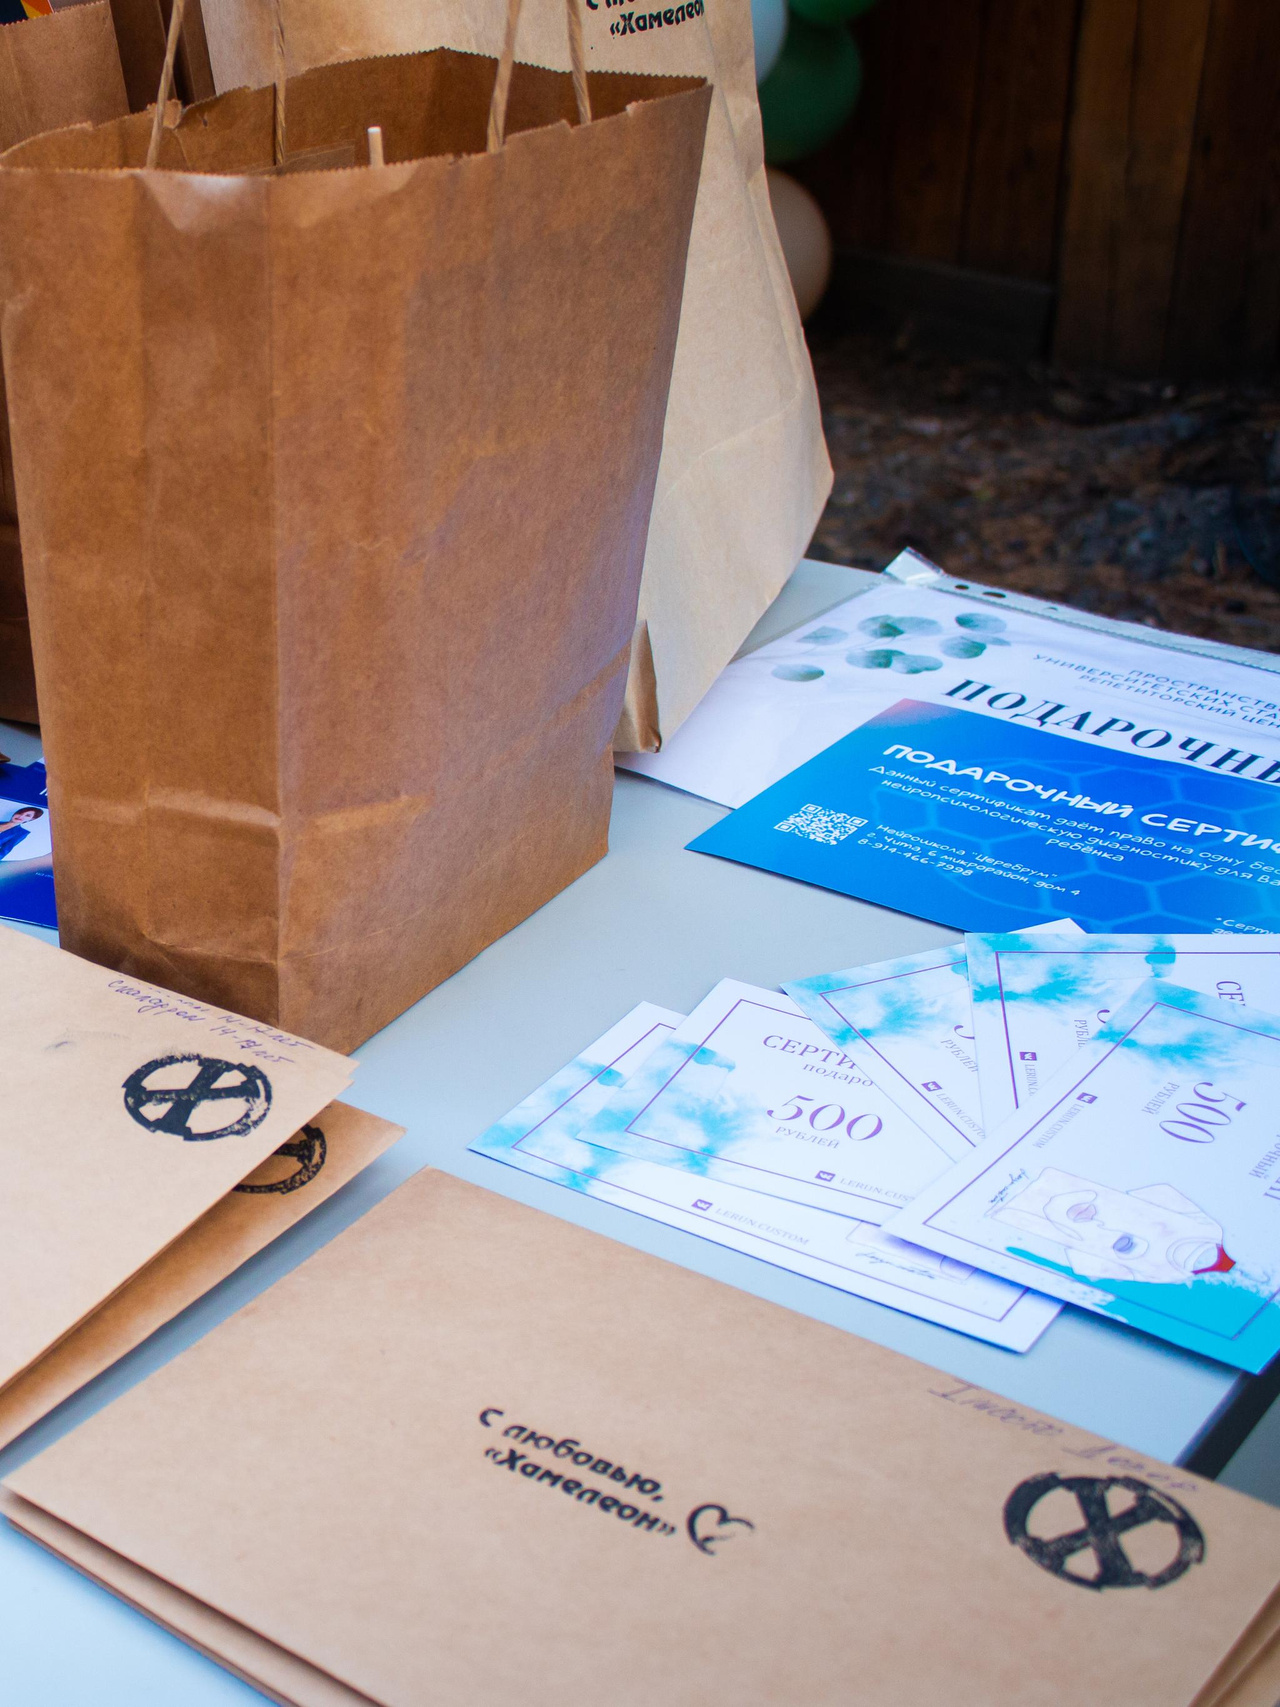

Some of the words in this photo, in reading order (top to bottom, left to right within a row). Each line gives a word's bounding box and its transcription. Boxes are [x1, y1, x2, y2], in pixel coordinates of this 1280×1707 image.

[609, 0, 705, 36] «Хамелео
[1033, 653, 1233, 707] УНИВЕРСИТЕТСКИХ
[1239, 705, 1280, 722] СТА
[1078, 674, 1237, 717] РЕПЕТИТОРСКИЙ
[1128, 669, 1280, 712] ПРОСТРАНСТВ
[883, 744, 1134, 818] ПОДАРОЧНЫЙ
[868, 765, 937, 788] Данный
[939, 784, 1051, 821] сертификат
[1053, 816, 1105, 834] даёт
[1108, 830, 1166, 849] право
[1170, 844, 1194, 855] на
[1198, 850, 1245, 866] одну
[880, 779, 1083, 840] нейропсихологическую
[1084, 835, 1213, 872] диагностику
[1214, 866, 1254, 880] для
[857, 838, 974, 877] 8-914-466-7998
[875, 824, 966, 856] Нейрошкола
[971, 851, 1058, 879] "Церебрум"
[884, 835, 923, 854] Чита,
[941, 854, 1030, 884] микрорайон,
[1033, 879, 1066, 893] дом
[1045, 837, 1125, 862] ребёнка
[802, 1063, 874, 1088] подаро
[1140, 1081, 1181, 1115] РУБЛЕЙ
[766, 1094, 883, 1141] 500
[1032, 1103, 1085, 1149] LERUN.CUSTOM
[1159, 1081, 1247, 1144] 500
[775, 1126, 841, 1149] РУБЛЕЙ
[715, 1207, 811, 1246] LERUN.CUSTOM
[478, 1407, 504, 1427] С
[502, 1424, 665, 1502] любовью,
[484, 1447, 677, 1536] «Хамелеон»
